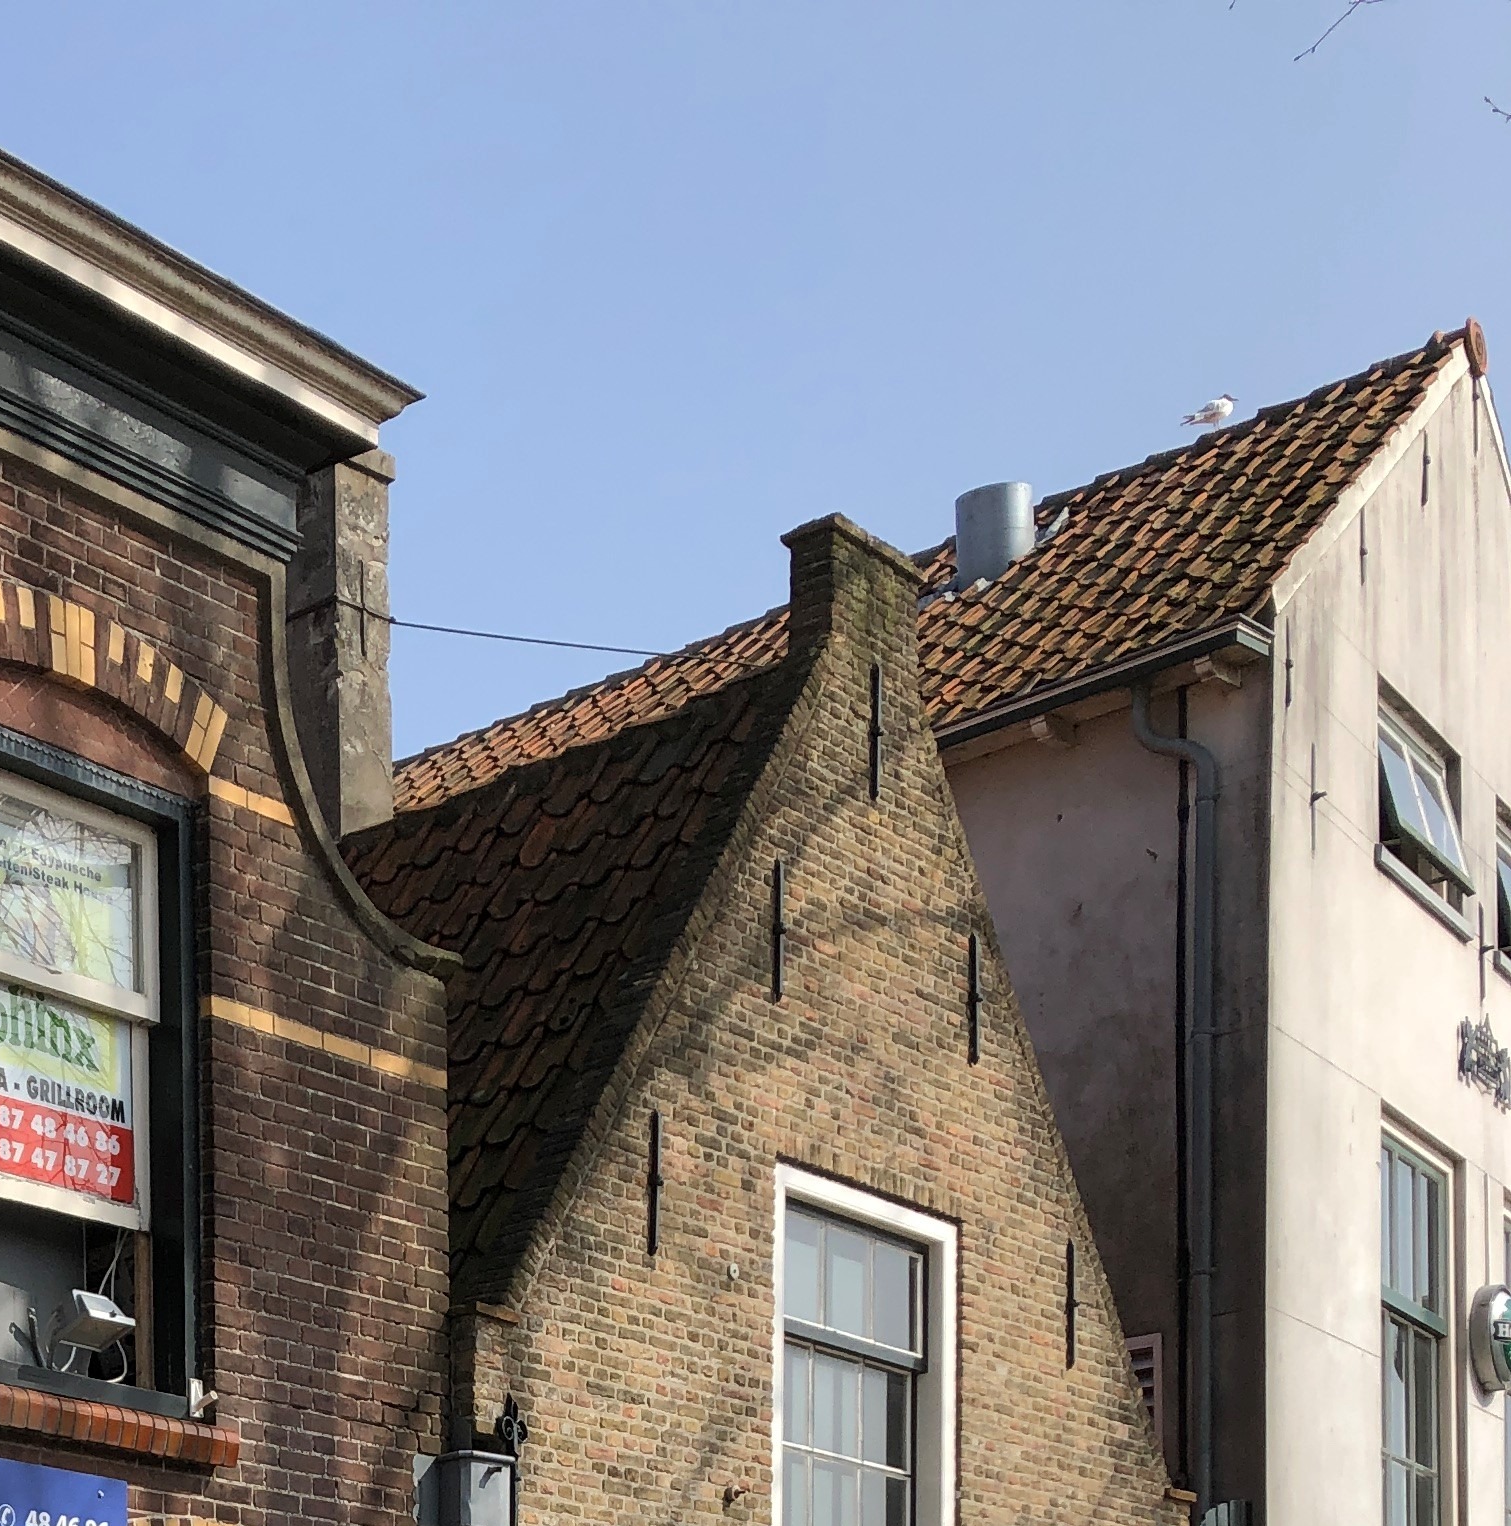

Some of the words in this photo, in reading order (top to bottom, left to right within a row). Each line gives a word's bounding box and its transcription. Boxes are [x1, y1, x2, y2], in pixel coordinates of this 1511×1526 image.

[26, 1075, 126, 1124] GRILLROOM
[30, 1114, 57, 1139] 48
[64, 1123, 88, 1147] 46
[95, 1130, 121, 1156] 86
[31, 1148, 58, 1172] 47
[64, 1155, 89, 1178] 87
[96, 1163, 122, 1187] 27
